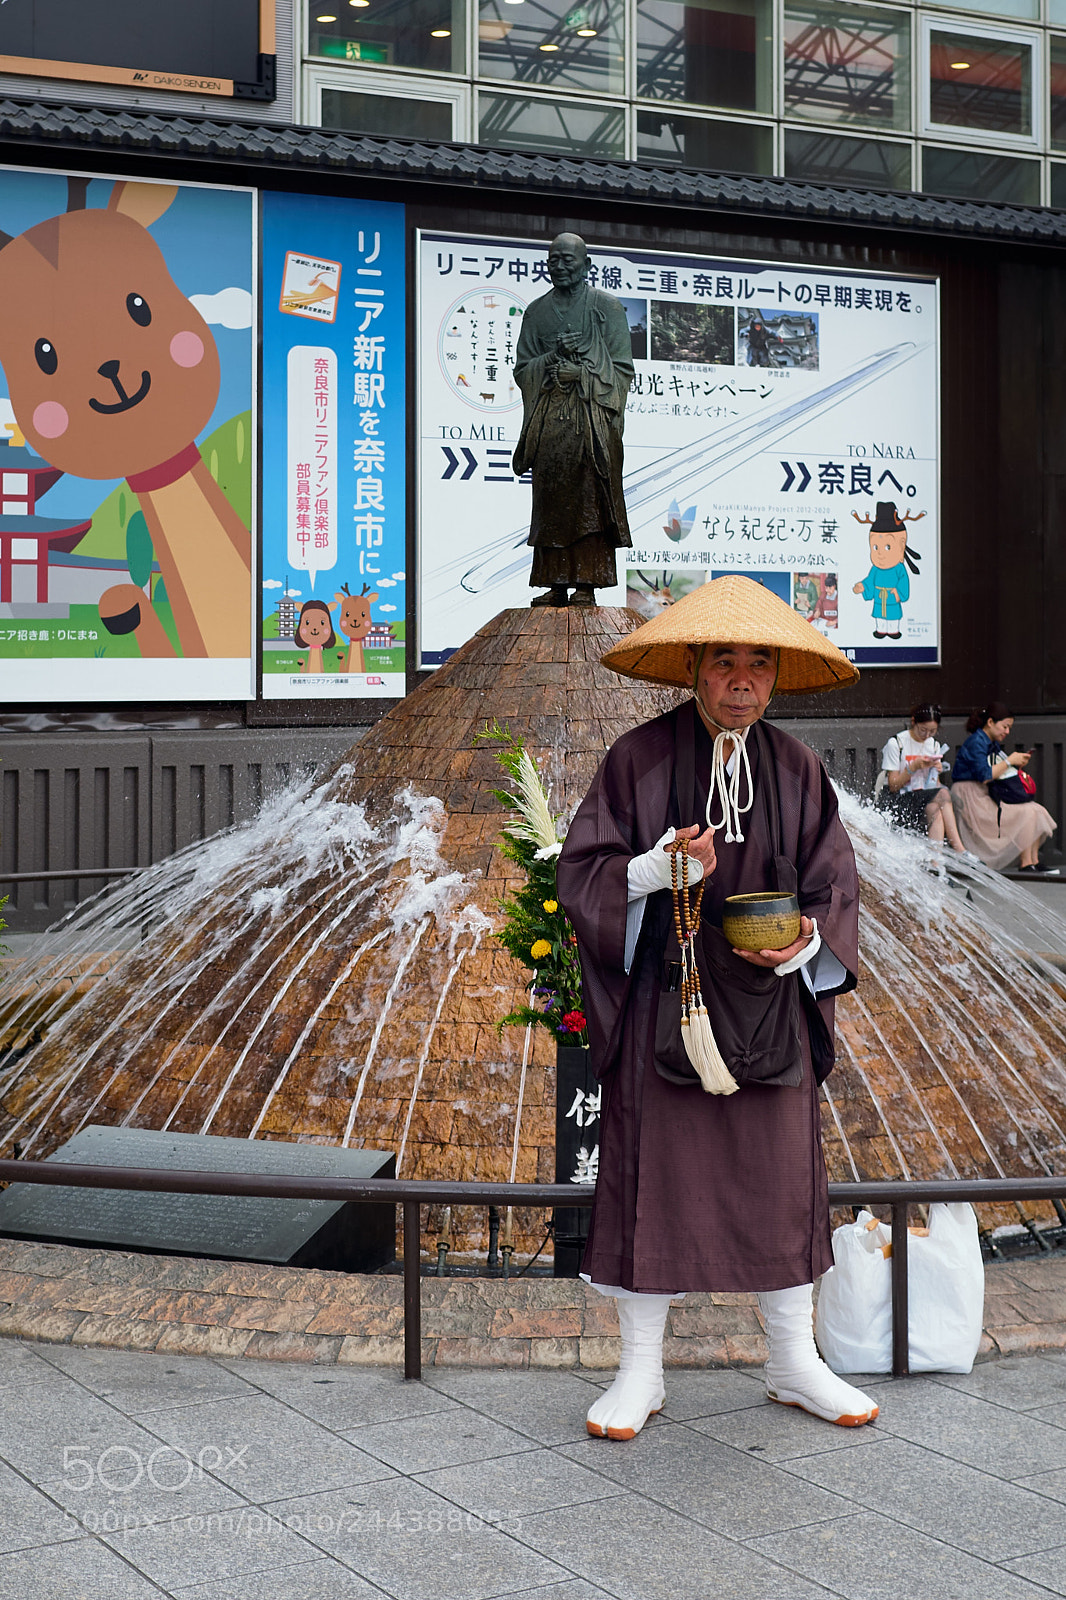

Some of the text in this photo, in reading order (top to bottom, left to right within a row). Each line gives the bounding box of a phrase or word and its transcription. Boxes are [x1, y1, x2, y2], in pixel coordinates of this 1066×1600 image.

[153, 76, 221, 90] DAIKO SENDEN
[437, 252, 924, 315] リニア中央幹線、三重・奈良ルートの早期実現を。
[353, 231, 387, 575] リニア新駅を奈良市に
[438, 425, 463, 440] TO
[846, 444, 867, 458] TO
[313, 358, 329, 549] 奈良市リニアファン倶楽部
[818, 461, 917, 498] 奈良へ。
[296, 462, 311, 565] 部員募集中！
[768, 505, 794, 513] Project
